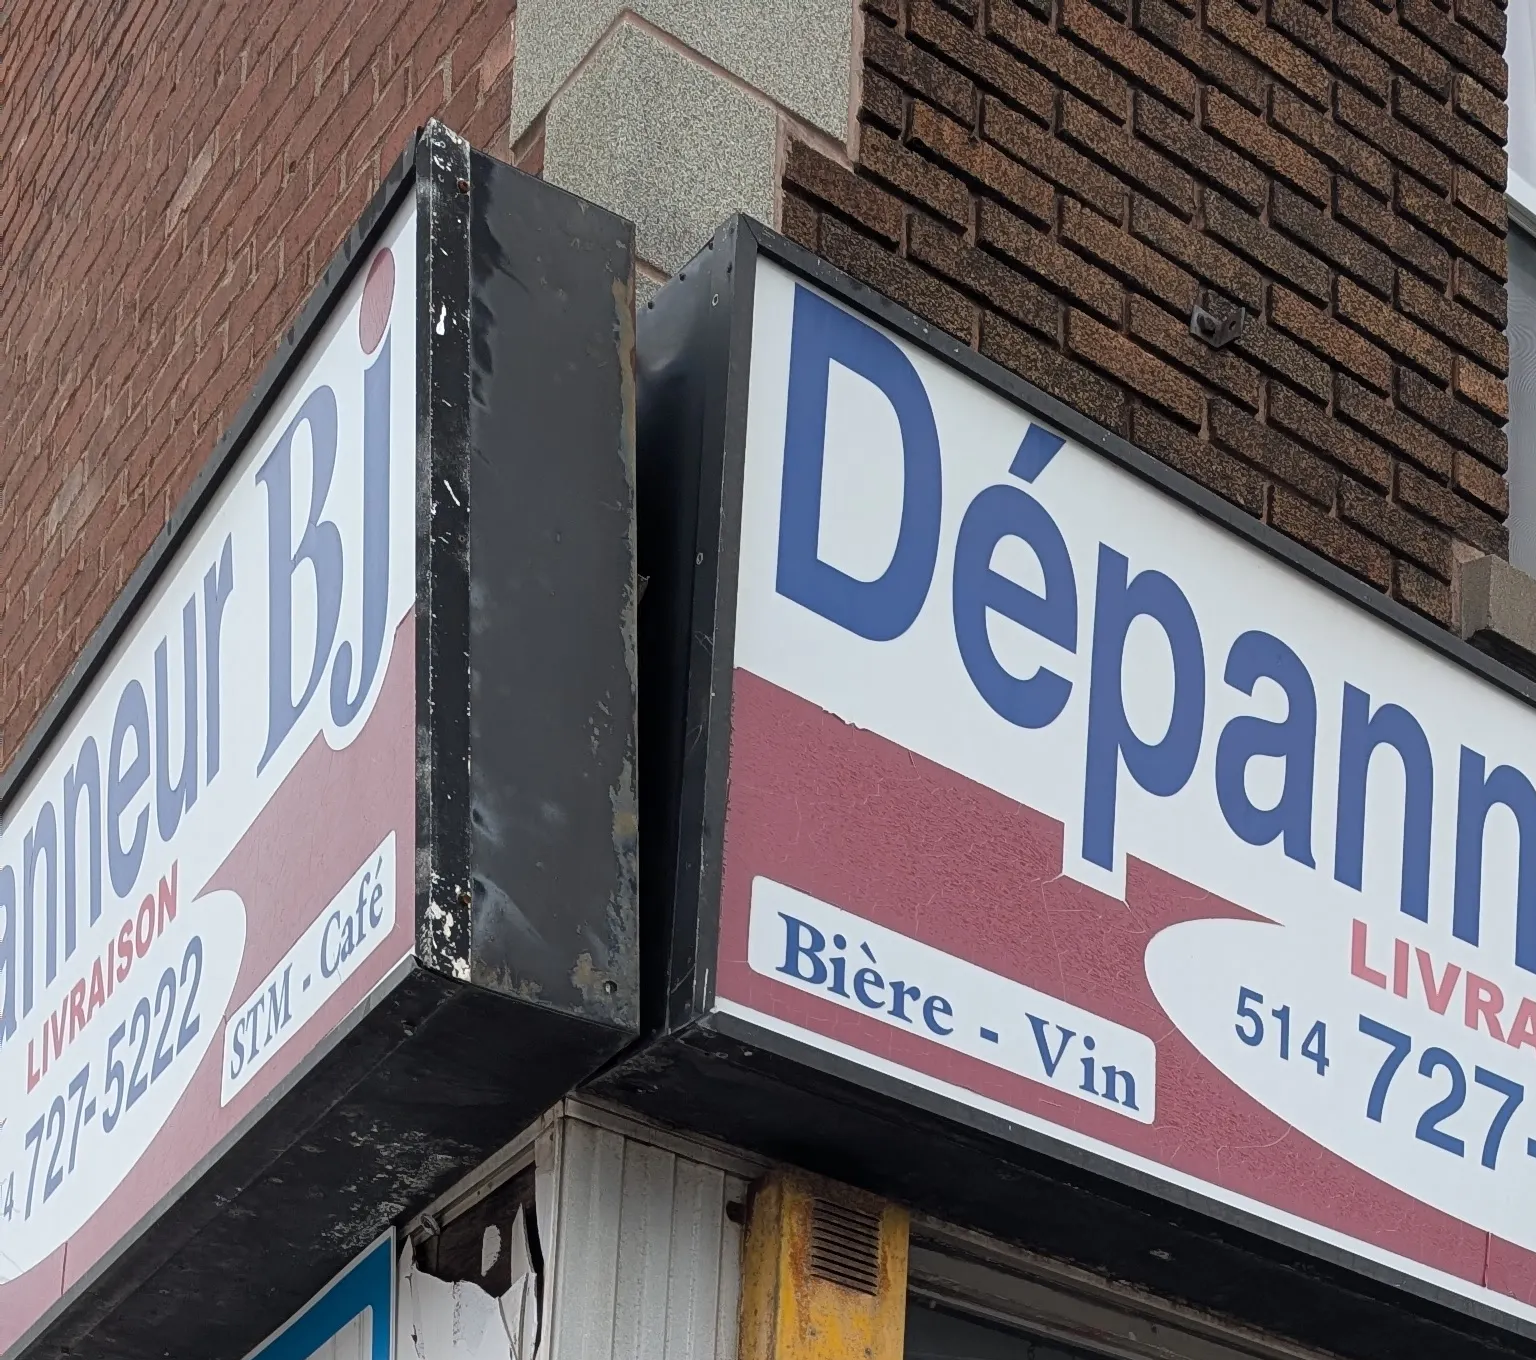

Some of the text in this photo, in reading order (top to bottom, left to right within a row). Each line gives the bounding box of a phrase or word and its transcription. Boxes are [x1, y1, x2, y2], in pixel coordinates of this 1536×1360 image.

[256, 247, 394, 776] Bj
[25, 935, 202, 1222] 727-5222
[27, 858, 177, 1094] LIVRAISON
[230, 856, 384, 1080] STM Café
[776, 912, 954, 1036] Bière
[1025, 1012, 1140, 1112] Vin
[1236, 987, 1330, 1075] 514
